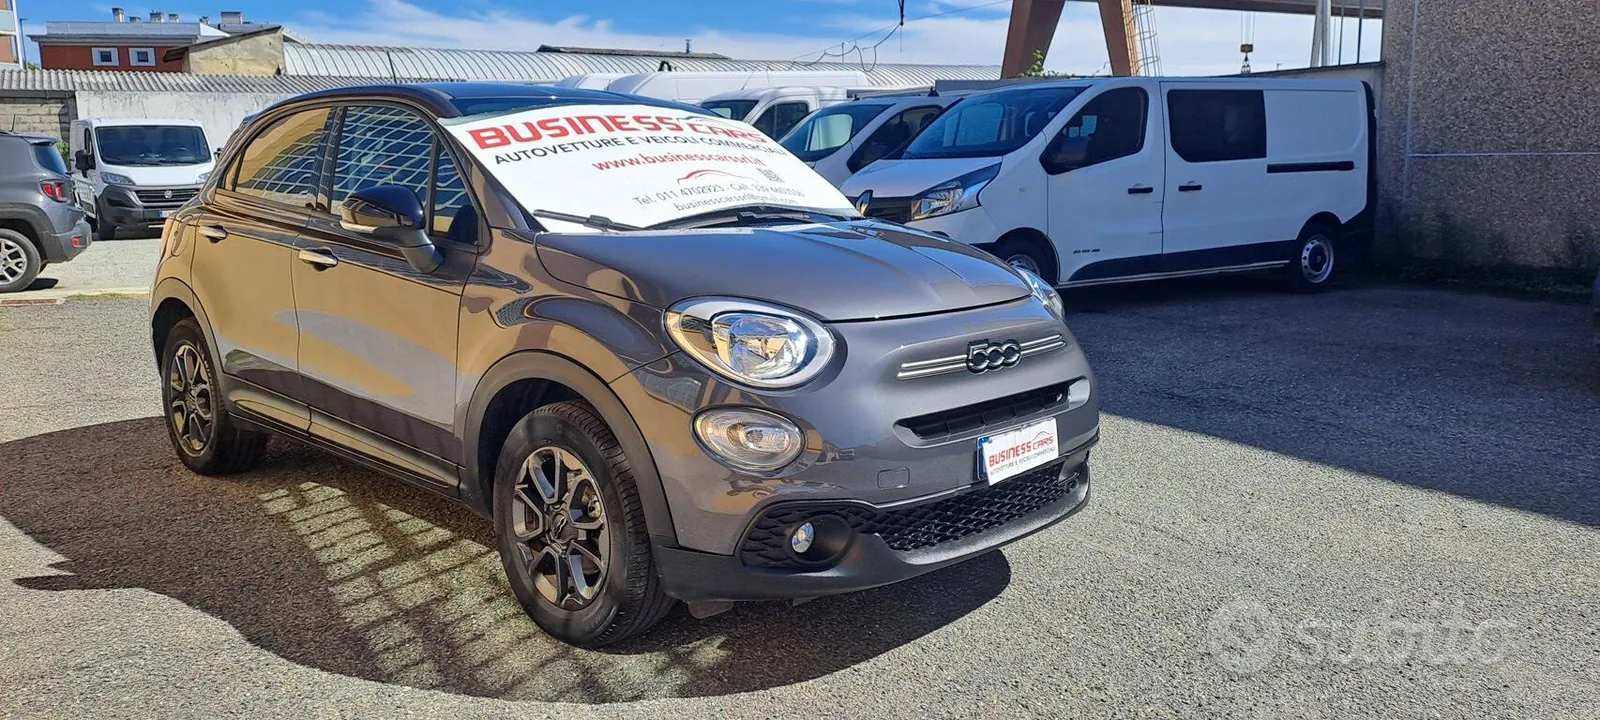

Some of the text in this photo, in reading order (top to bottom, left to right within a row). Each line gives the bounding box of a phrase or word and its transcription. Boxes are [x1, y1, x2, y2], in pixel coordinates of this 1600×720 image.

[466, 115, 768, 149] BUSINESS CARS
[494, 136, 788, 165] AUTOVETTURE E VEICOLI COMMERCIALI
[591, 153, 767, 171] www.businesscarssrl.it
[632, 195, 657, 207] Tel.
[656, 190, 678, 202] 011
[966, 338, 1021, 373] 500
[989, 435, 1054, 467] BUSINESS CARS
